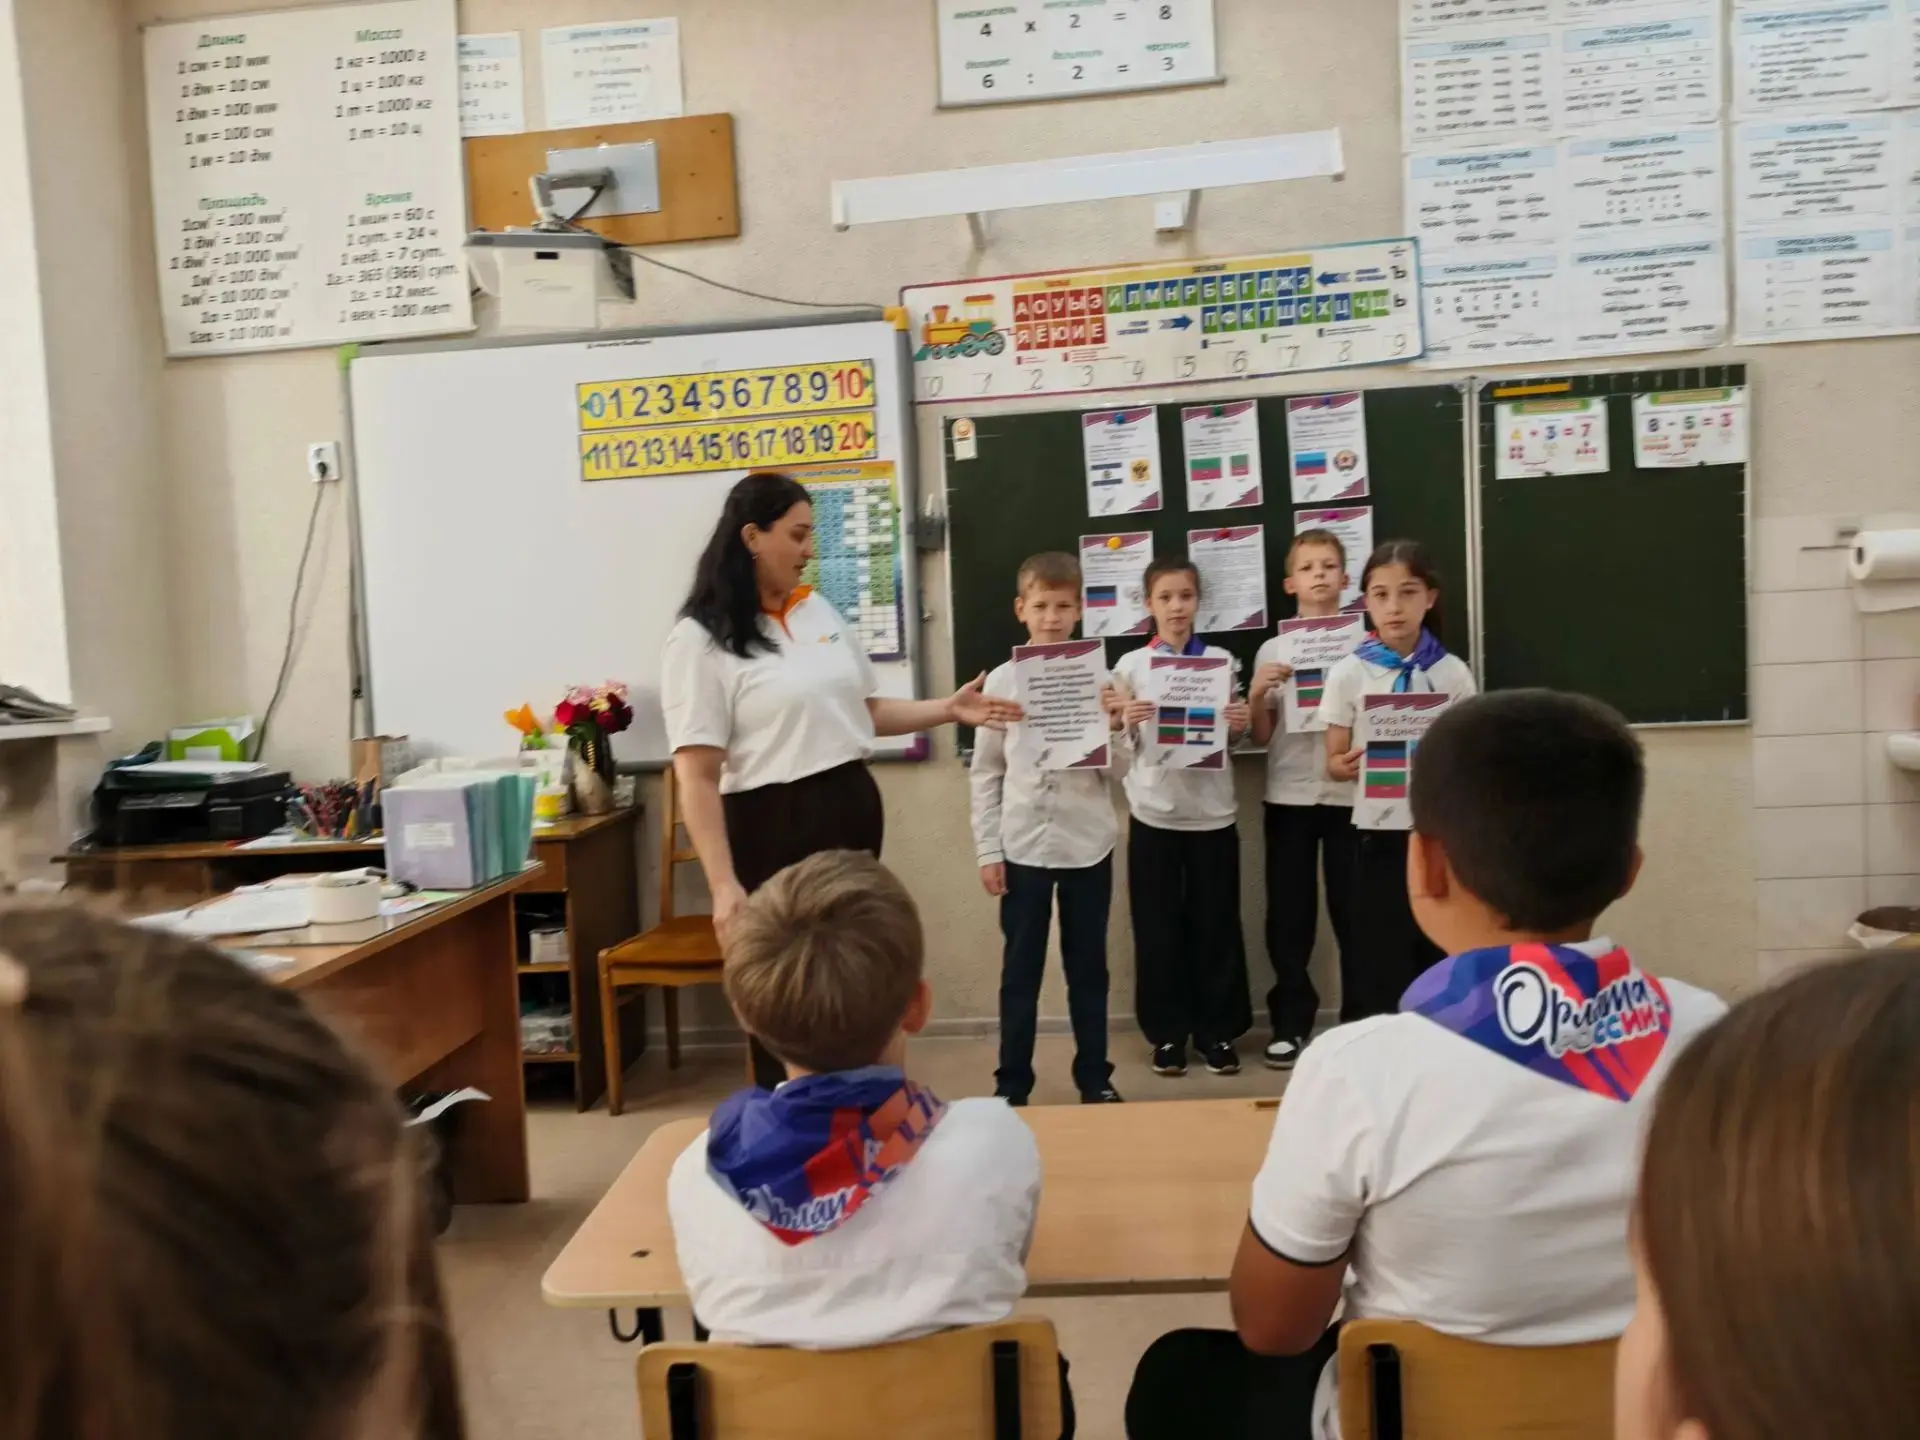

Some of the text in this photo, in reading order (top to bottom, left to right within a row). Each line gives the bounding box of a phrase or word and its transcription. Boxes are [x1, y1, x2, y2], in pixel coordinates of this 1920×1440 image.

[980, 23, 992, 37] 4
[1070, 14, 1080, 28] 2
[1113, 12, 1127, 20] =
[1159, 5, 1172, 20] 8
[982, 74, 994, 88] 6
[1072, 66, 1084, 80] 2
[1117, 64, 1128, 72] =
[1163, 57, 1174, 71] 3
[406, 207, 424, 221] 60
[386, 285, 404, 298] 12
[1164, 286, 1178, 301] Н
[1184, 284, 1197, 299] Р
[1204, 283, 1216, 298] Б
[1222, 281, 1236, 296] В
[1241, 278, 1253, 293] Г
[1016, 294, 1103, 316] А О У Ы Э
[1242, 308, 1255, 322] К
[1260, 307, 1274, 321] Т
[1298, 302, 1312, 318] С
[1316, 301, 1330, 316] Х
[1017, 330, 1031, 344] Я
[1051, 326, 1070, 340] Ю
[1072, 324, 1085, 339] И
[1090, 322, 1103, 337] Е
[587, 368, 865, 418] 0 1 2 3 4 5 6 7 8 9 10
[1510, 428, 1523, 440] 4
[1546, 426, 1558, 440] 3
[1580, 424, 1592, 438] 7
[1649, 418, 1660, 432] 8
[1684, 416, 1696, 430] 5
[1721, 412, 1733, 427] 3
[591, 422, 866, 470] 11 12 13 14 15 16 17 18 19 20
